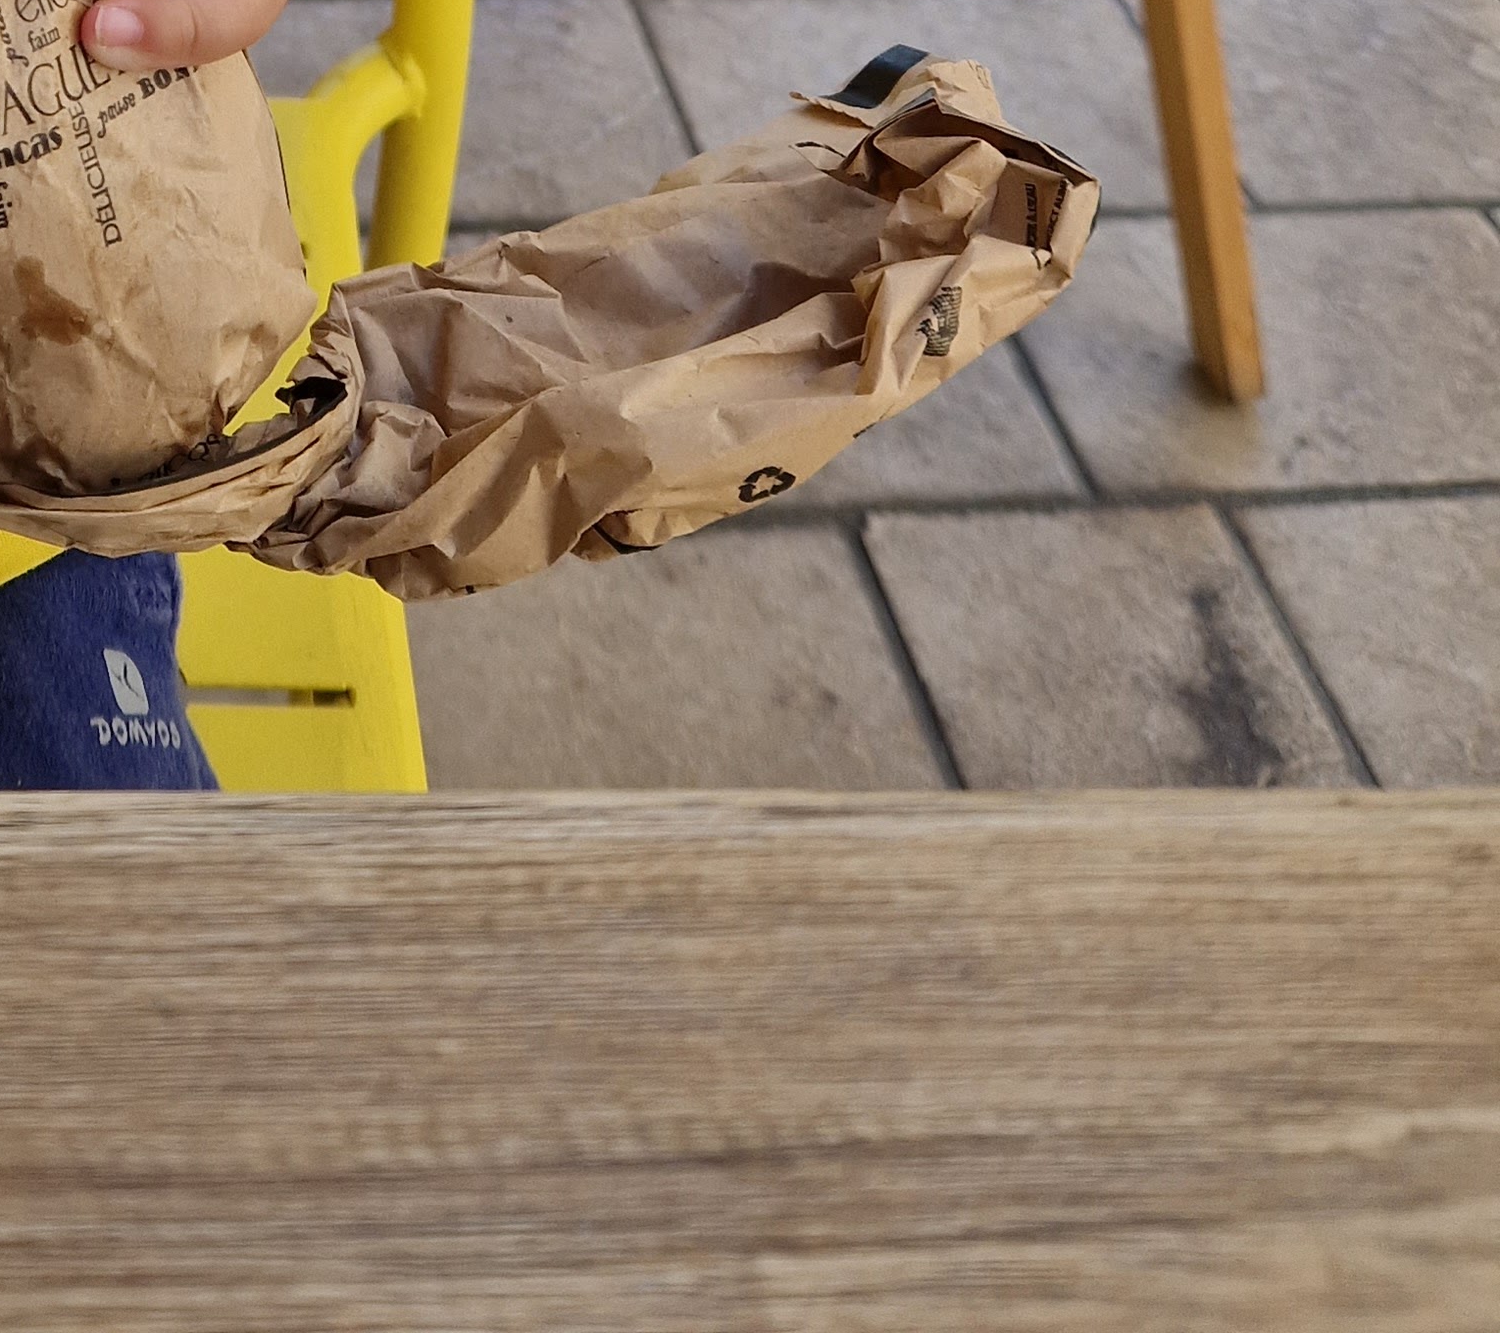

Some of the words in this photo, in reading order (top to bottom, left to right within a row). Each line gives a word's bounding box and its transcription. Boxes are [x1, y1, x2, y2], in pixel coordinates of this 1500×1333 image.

[28, 26, 61, 53] faim
[97, 94, 136, 139] pause
[68, 102, 122, 247] DÉLICIEUSE
